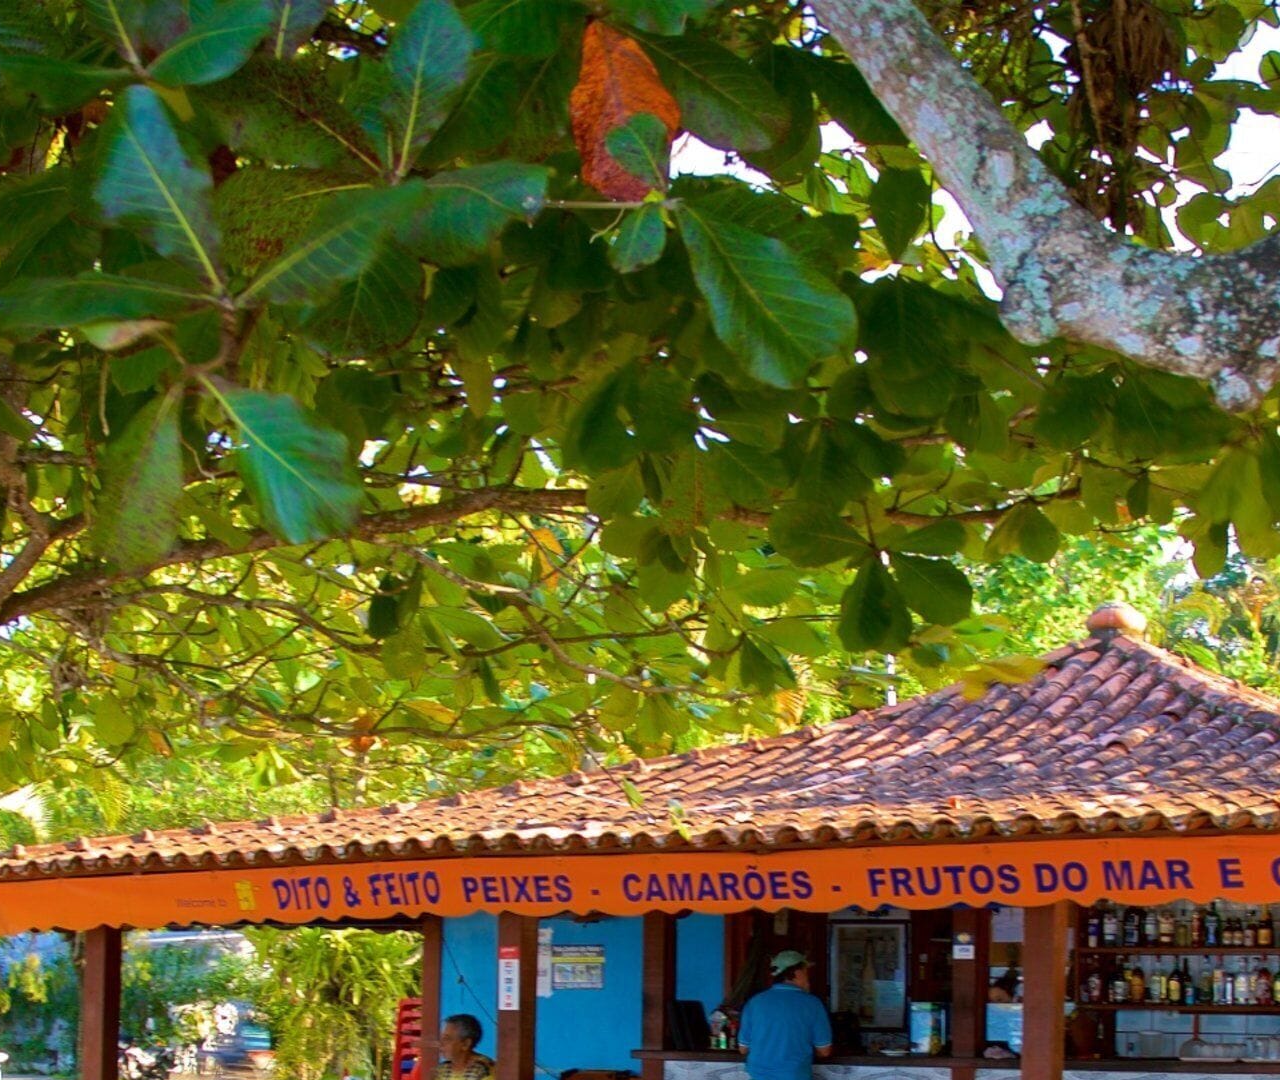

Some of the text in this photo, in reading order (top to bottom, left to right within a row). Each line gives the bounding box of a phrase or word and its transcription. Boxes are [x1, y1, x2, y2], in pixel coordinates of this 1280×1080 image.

[271, 876, 331, 910] DITO
[343, 876, 361, 907] &
[368, 870, 441, 906] FEITO
[461, 874, 573, 903] PEIXES
[622, 864, 814, 902] CAMARÕES
[866, 863, 1021, 897] FRUTOS
[1033, 861, 1089, 893] DO
[1101, 859, 1195, 891] MAR
[1217, 858, 1245, 889] E
